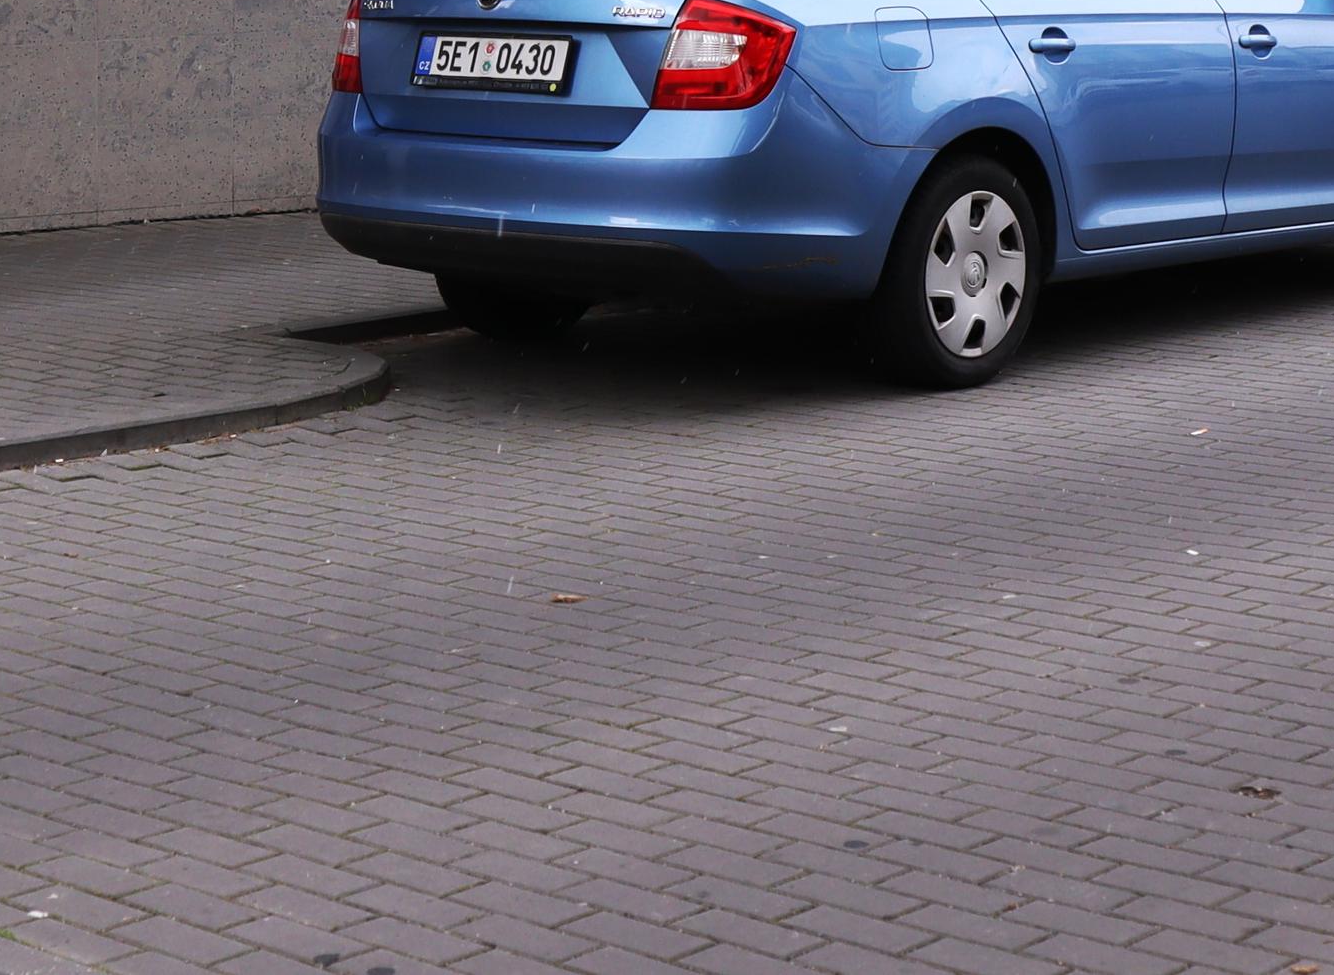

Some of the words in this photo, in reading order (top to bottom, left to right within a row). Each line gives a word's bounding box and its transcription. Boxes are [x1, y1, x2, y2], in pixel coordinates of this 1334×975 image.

[612, 5, 667, 19] RAPID
[418, 60, 430, 71] CZ
[436, 39, 478, 73] 5E1
[497, 42, 556, 76] 0430
